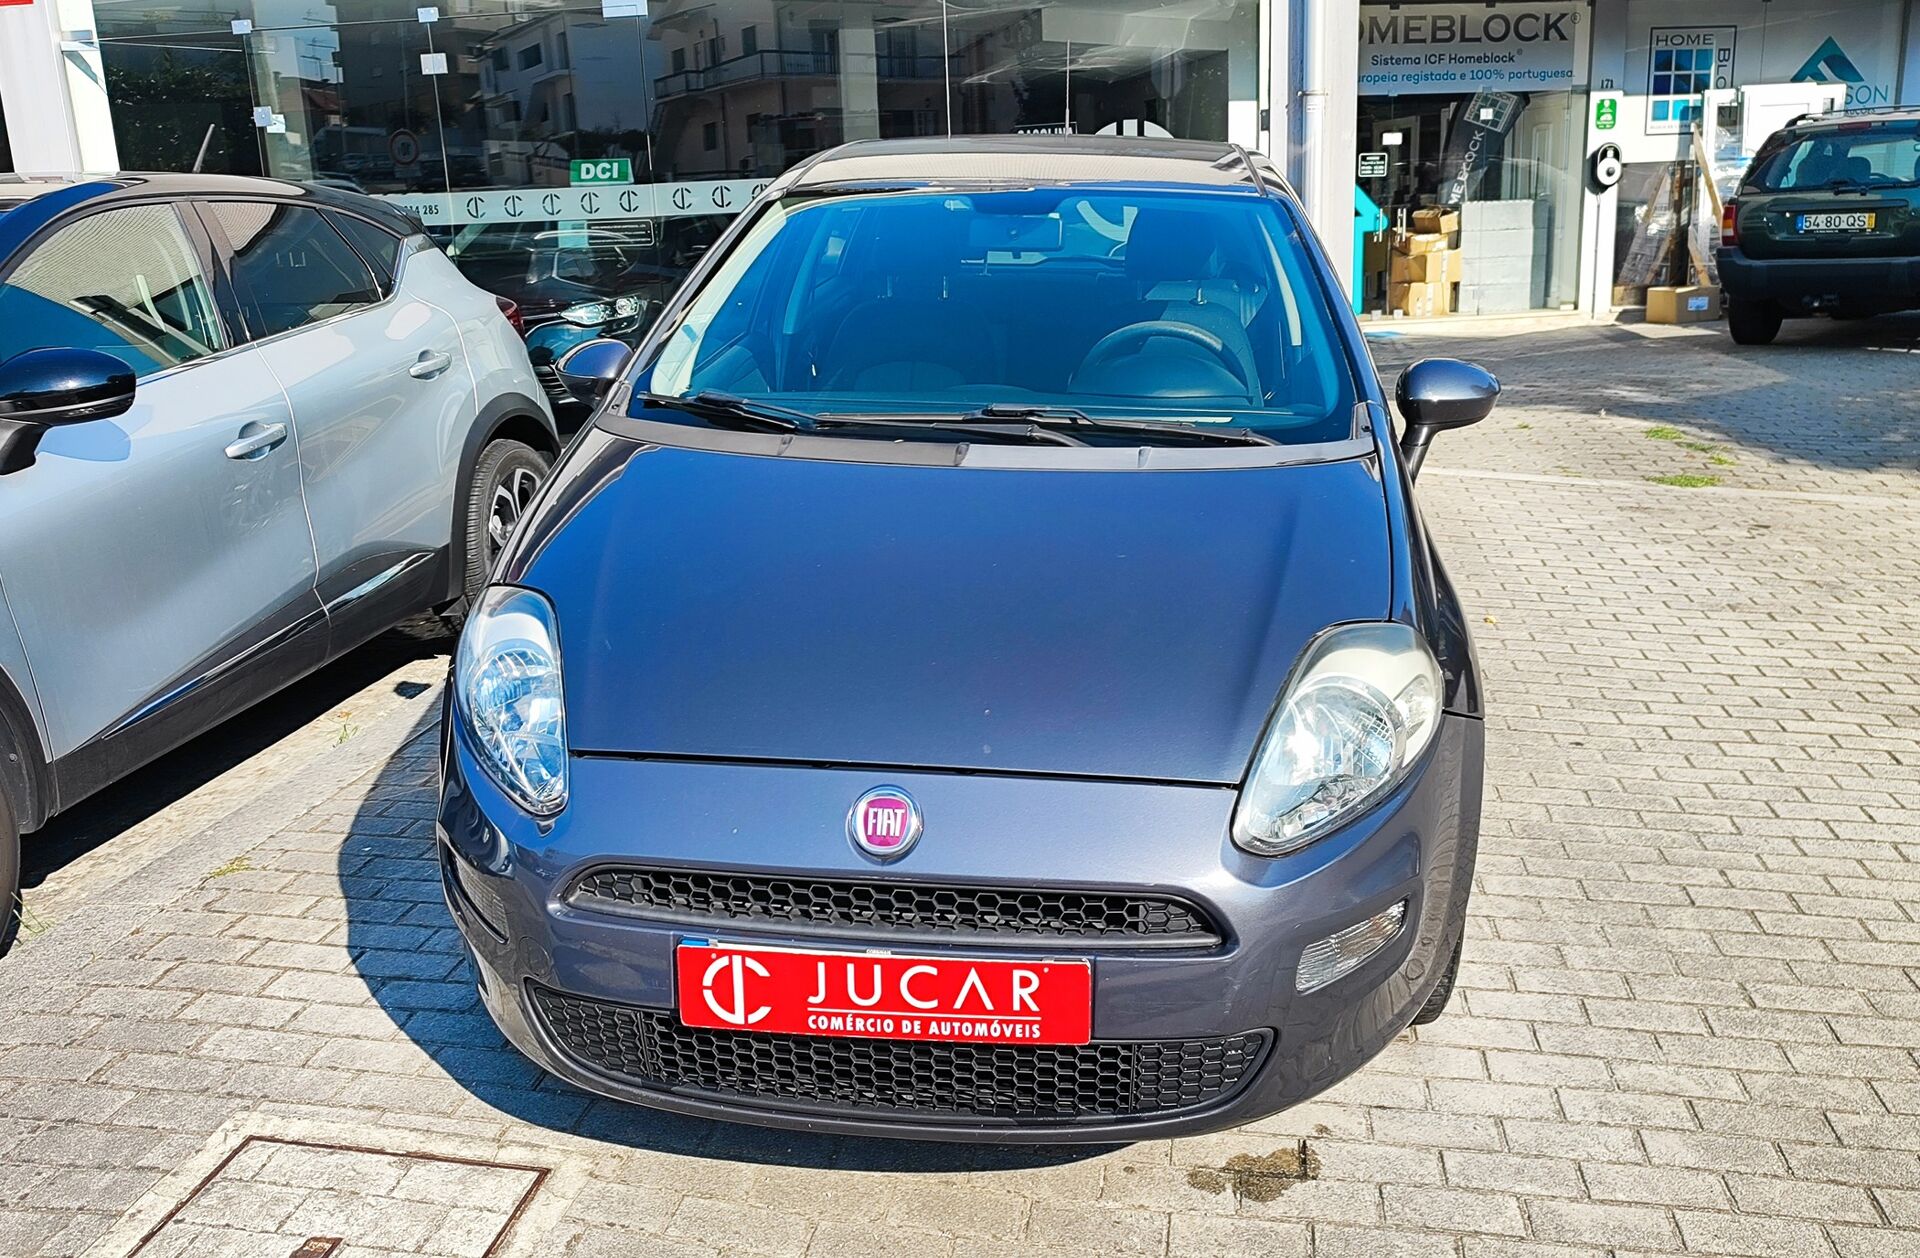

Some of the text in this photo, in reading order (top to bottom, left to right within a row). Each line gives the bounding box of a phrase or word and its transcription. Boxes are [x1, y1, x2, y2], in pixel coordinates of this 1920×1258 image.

[1655, 34, 1714, 46] HOME
[1371, 54, 1421, 66] Sistema
[1424, 54, 1446, 65] ICF
[1402, 70, 1457, 85] registada
[1459, 73, 1466, 81] e
[1470, 69, 1504, 81] 100%
[1600, 78, 1614, 89] 171
[580, 163, 619, 180] DCI
[423, 204, 439, 215] 285
[866, 807, 906, 837] FIAT
[807, 961, 1040, 1012] JUCAR
[807, 1014, 1041, 1039] COMÉRCIO DE AUTOMÓVEIS
